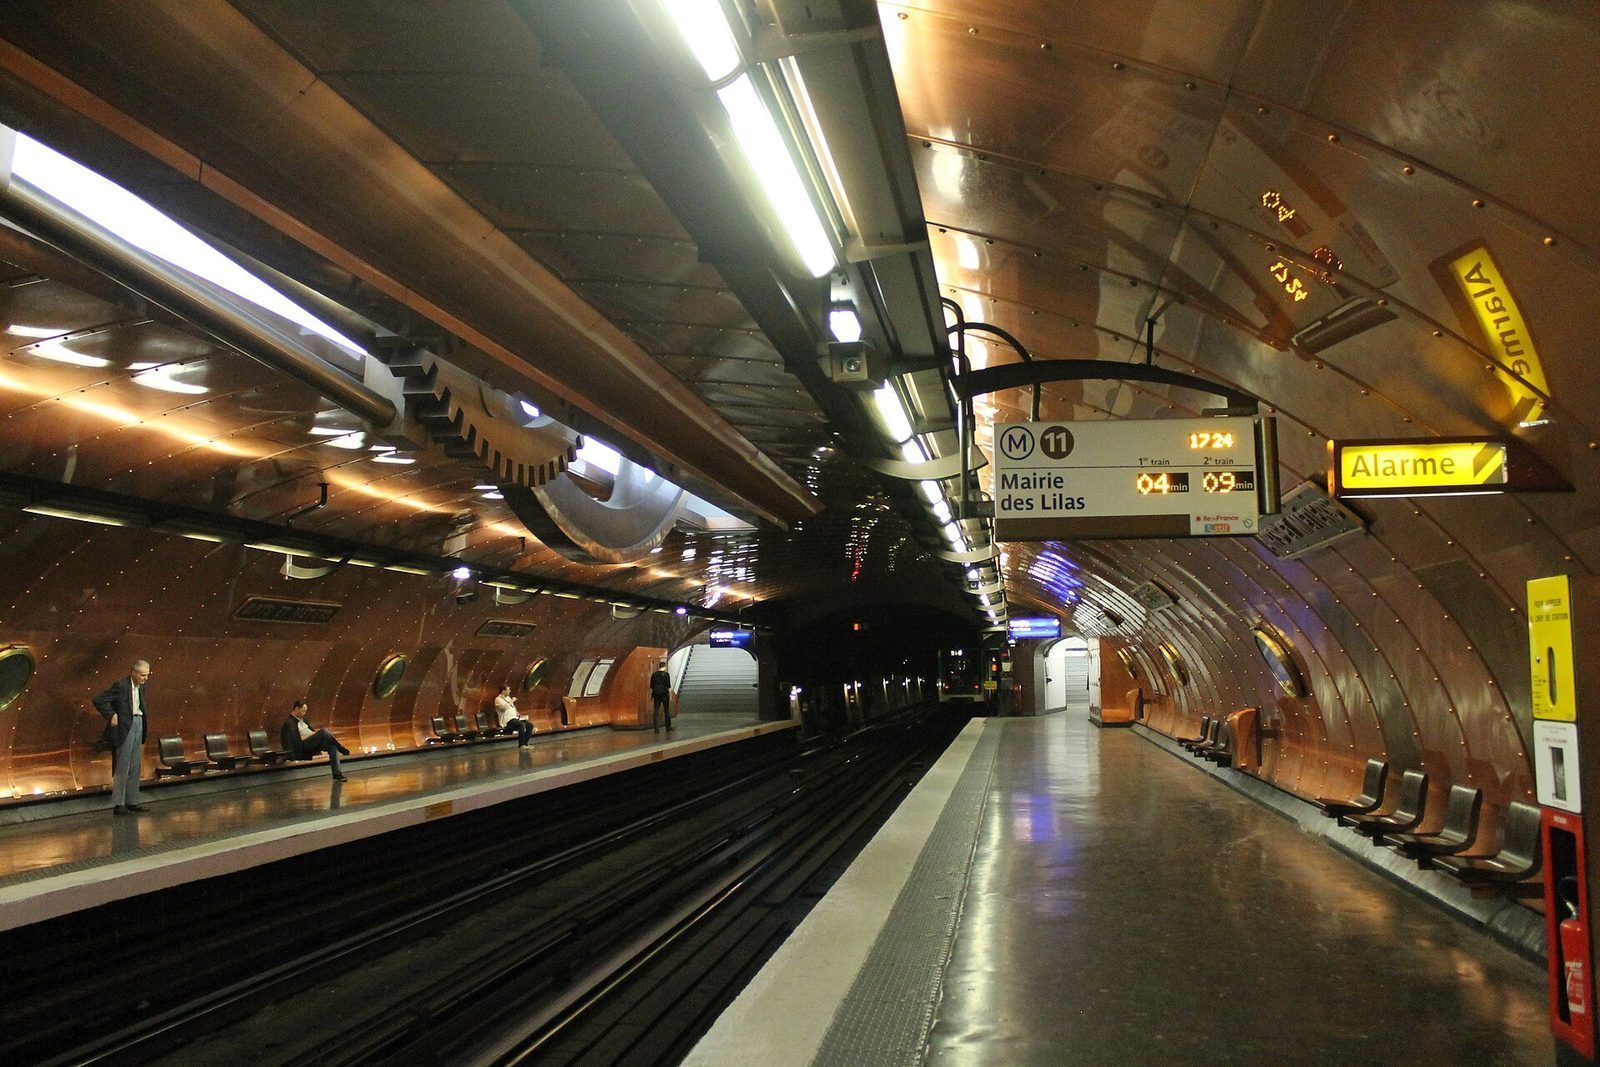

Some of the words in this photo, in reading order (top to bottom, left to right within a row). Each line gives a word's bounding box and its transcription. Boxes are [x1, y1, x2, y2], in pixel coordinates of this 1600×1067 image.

[1044, 432, 1067, 453] 11
[1151, 458, 1170, 466] train
[1215, 457, 1234, 465] train
[1351, 453, 1455, 478] Alarme
[1001, 472, 1064, 490] Mairie
[1137, 472, 1170, 495] 04
[1170, 482, 1188, 492] min
[1202, 472, 1235, 494] 09
[1235, 481, 1253, 490] min
[1001, 494, 1034, 511] des
[1041, 493, 1085, 510] Lilas
